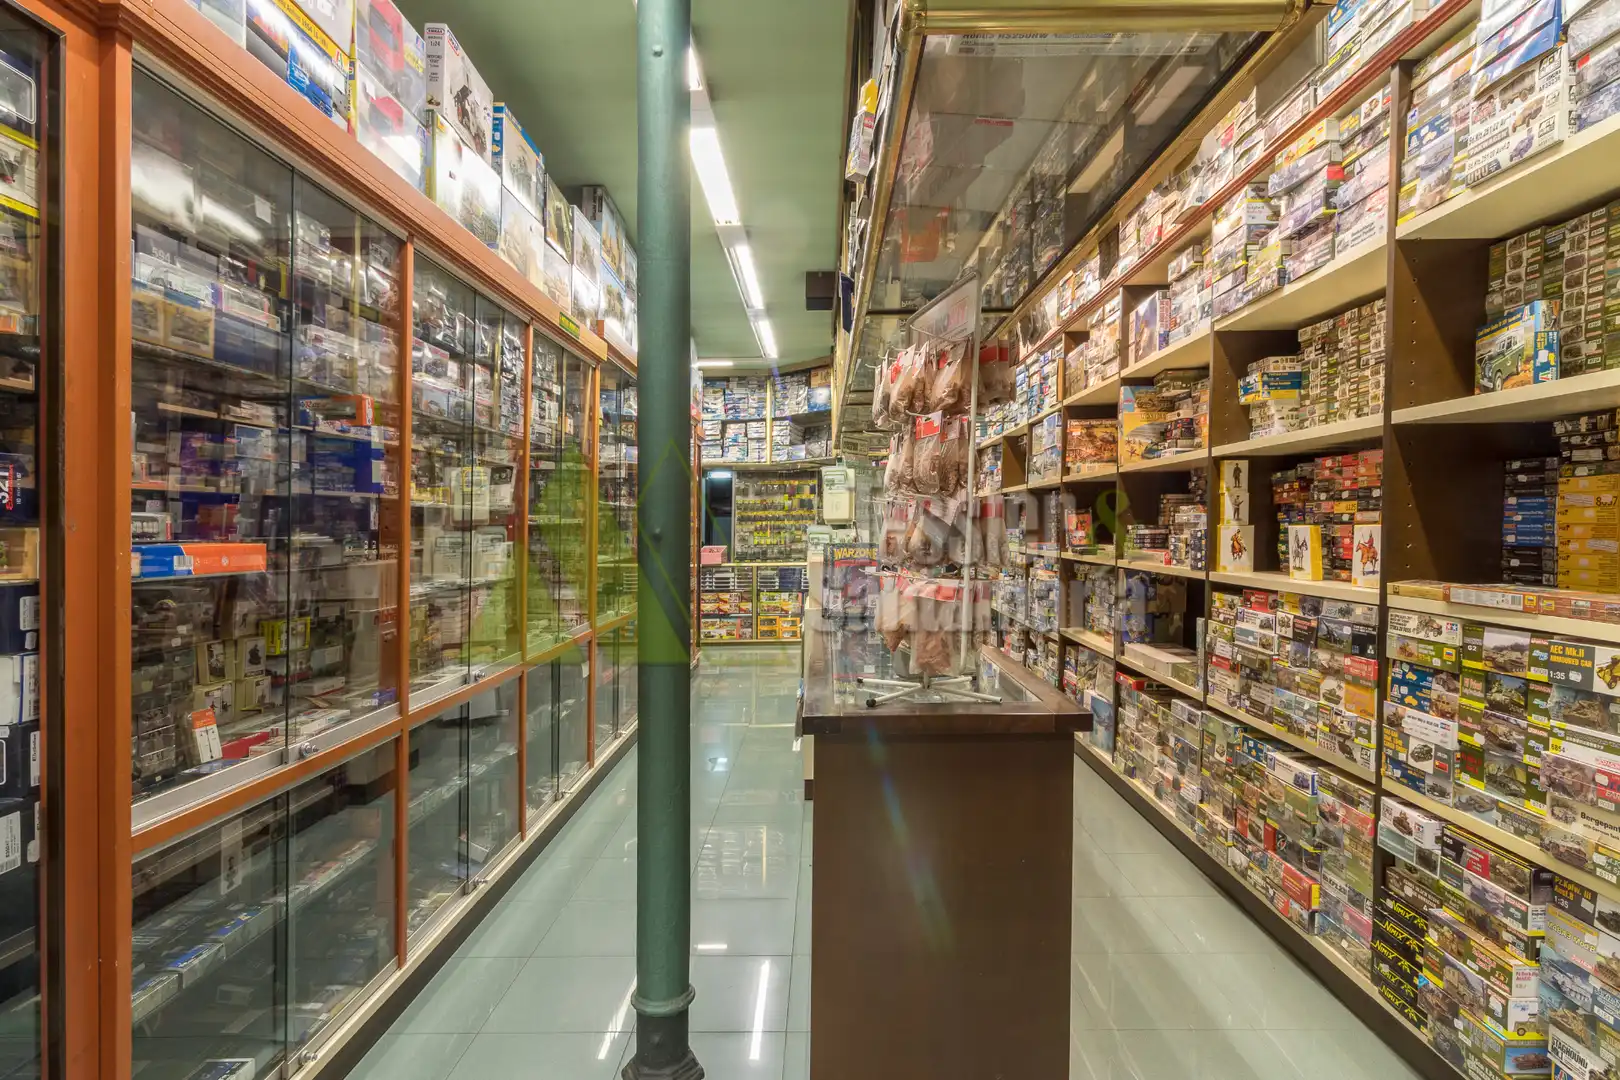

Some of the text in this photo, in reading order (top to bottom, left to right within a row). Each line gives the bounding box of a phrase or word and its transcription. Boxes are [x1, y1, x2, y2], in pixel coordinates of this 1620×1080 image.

[834, 547, 878, 560] WARZONE
[1550, 645, 1563, 655] AEC
[1550, 655, 1592, 668] ARMOURED CAR
[1549, 670, 1565, 680] 1:35
[1554, 895, 1569, 909] 1:35
[1391, 900, 1413, 921] NIMIX
[1383, 920, 1405, 941] NIMIX
[1375, 939, 1396, 961] NIMIX
[1380, 984, 1402, 1007] NIMIX
